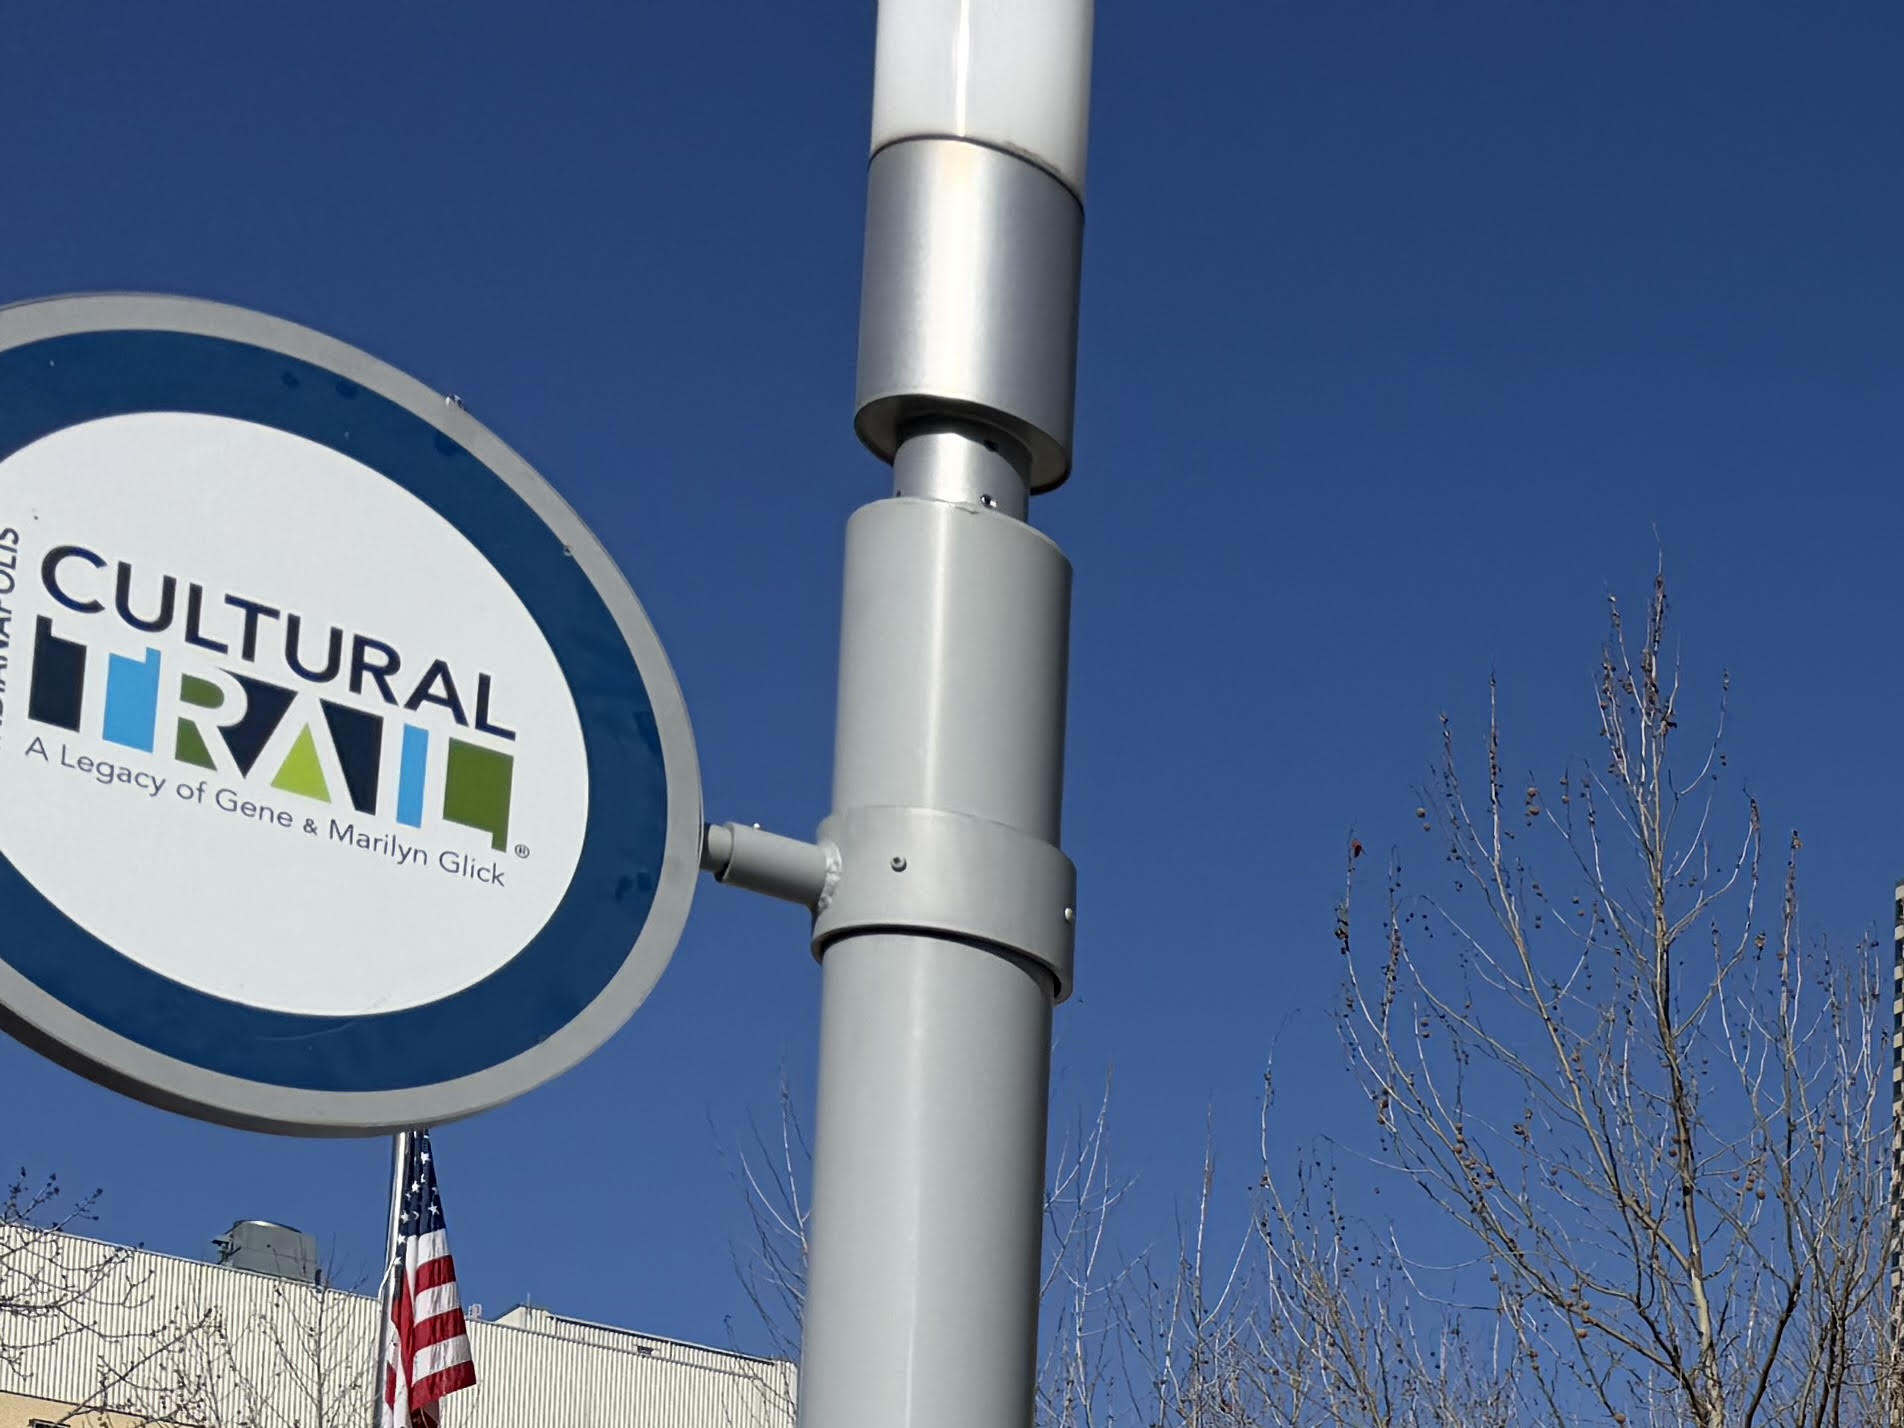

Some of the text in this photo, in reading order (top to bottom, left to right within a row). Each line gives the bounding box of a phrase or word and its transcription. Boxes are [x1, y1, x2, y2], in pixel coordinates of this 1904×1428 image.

[28, 613, 515, 854] TRAIL
[40, 544, 517, 742] CULTURAL
[25, 735, 505, 887] A Legacy of Gene & Marilyn Glick
